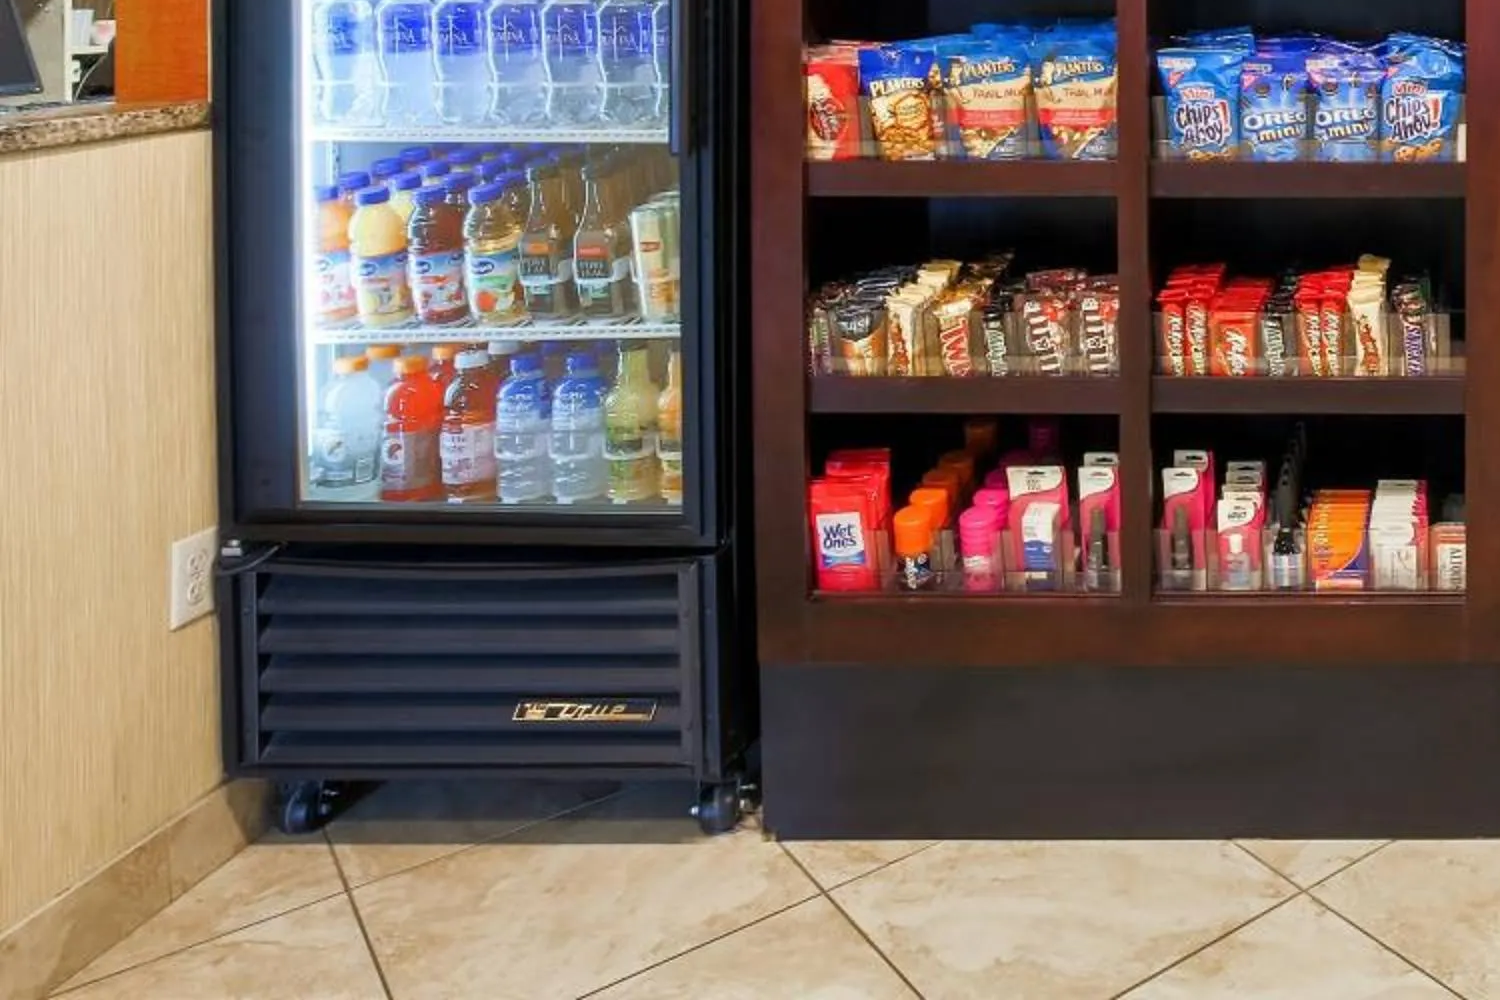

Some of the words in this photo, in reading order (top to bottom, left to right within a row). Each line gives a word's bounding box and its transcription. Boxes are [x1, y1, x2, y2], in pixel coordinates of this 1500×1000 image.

[870, 77, 925, 96] PLANTERS
[1176, 102, 1221, 128] Chips
[822, 522, 855, 539] Wet
[822, 535, 857, 550] Ones
